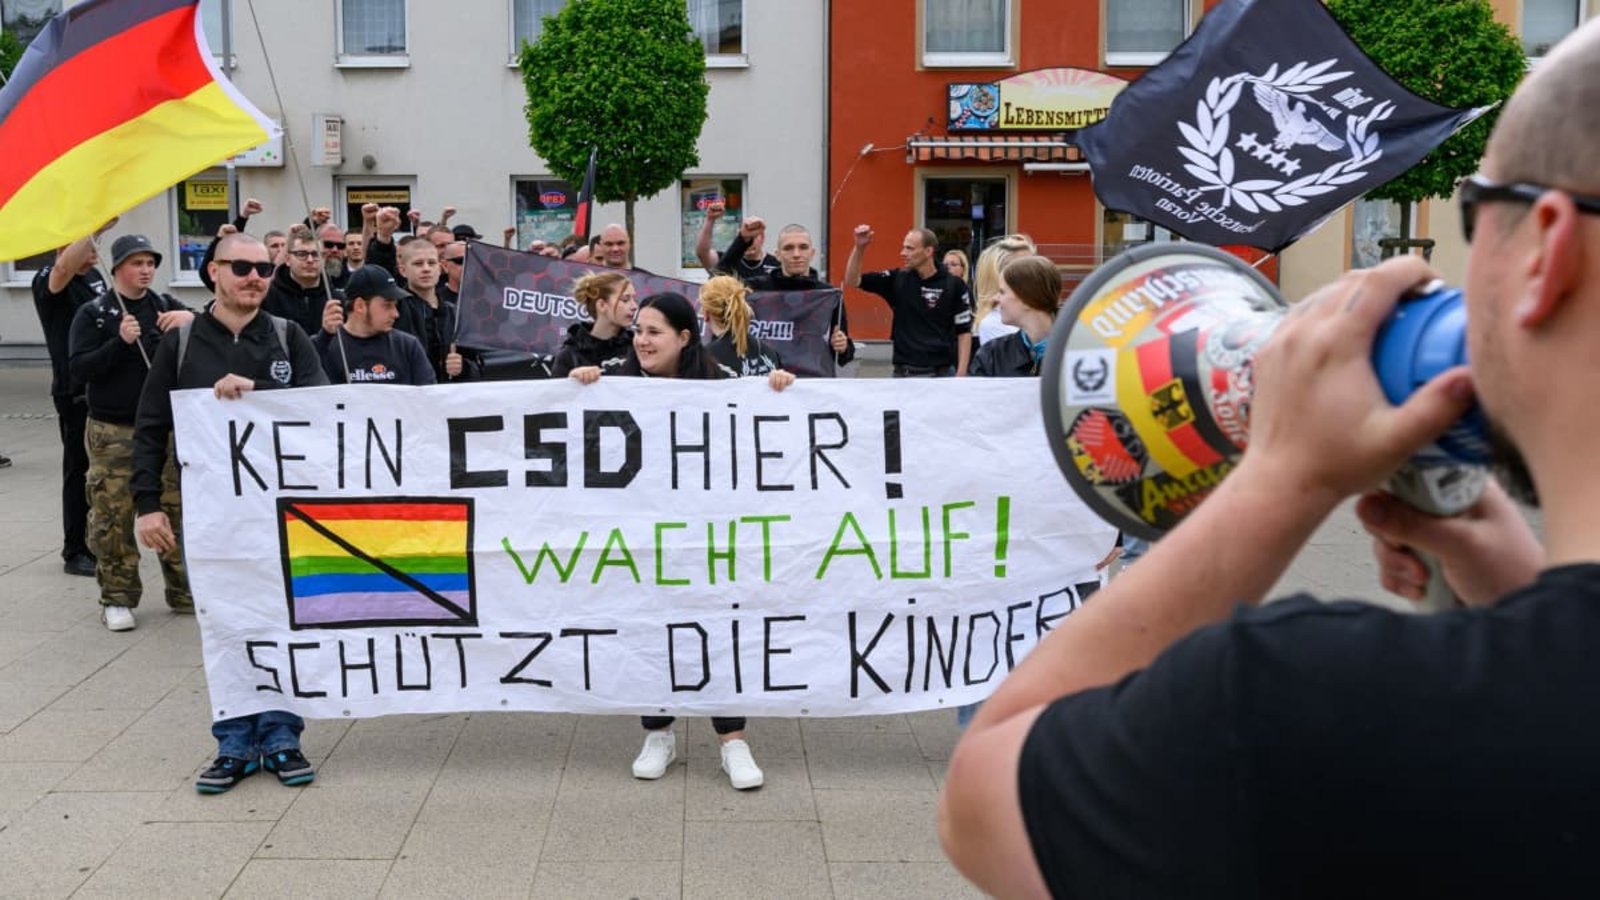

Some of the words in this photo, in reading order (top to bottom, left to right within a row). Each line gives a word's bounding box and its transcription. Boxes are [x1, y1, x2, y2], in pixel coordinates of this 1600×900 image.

[503, 287, 594, 322] DEUTSC
[350, 369, 395, 381] ellesse
[447, 410, 642, 489] CSD
[501, 515, 791, 586] WACHT
[246, 627, 618, 698] SCHÜTZT
[848, 582, 1100, 698] KINDER
